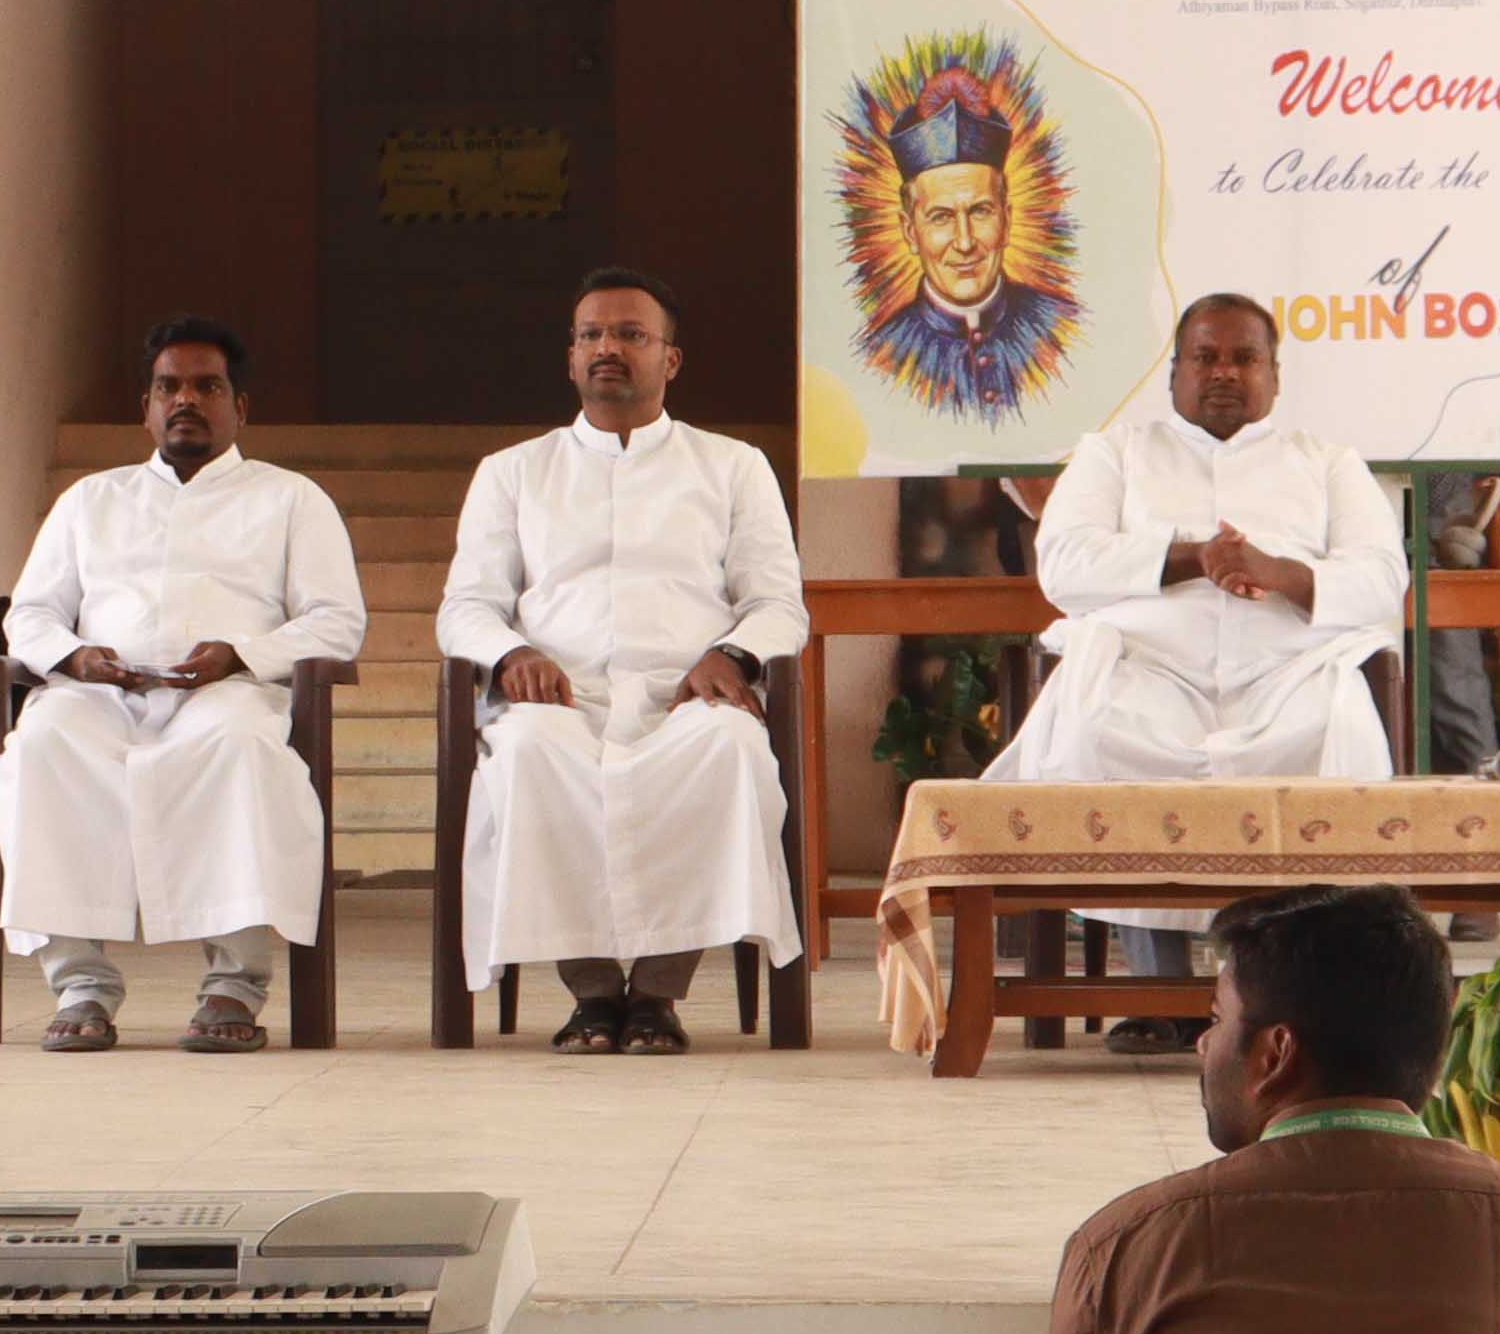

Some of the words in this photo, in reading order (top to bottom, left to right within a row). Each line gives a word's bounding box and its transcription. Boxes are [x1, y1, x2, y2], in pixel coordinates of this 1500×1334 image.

[1209, 163, 1246, 195] to
[1263, 152, 1423, 194] Celebrate
[1428, 159, 1489, 191] the
[1368, 225, 1450, 313] of
[1271, 294, 1407, 341] JOHN
